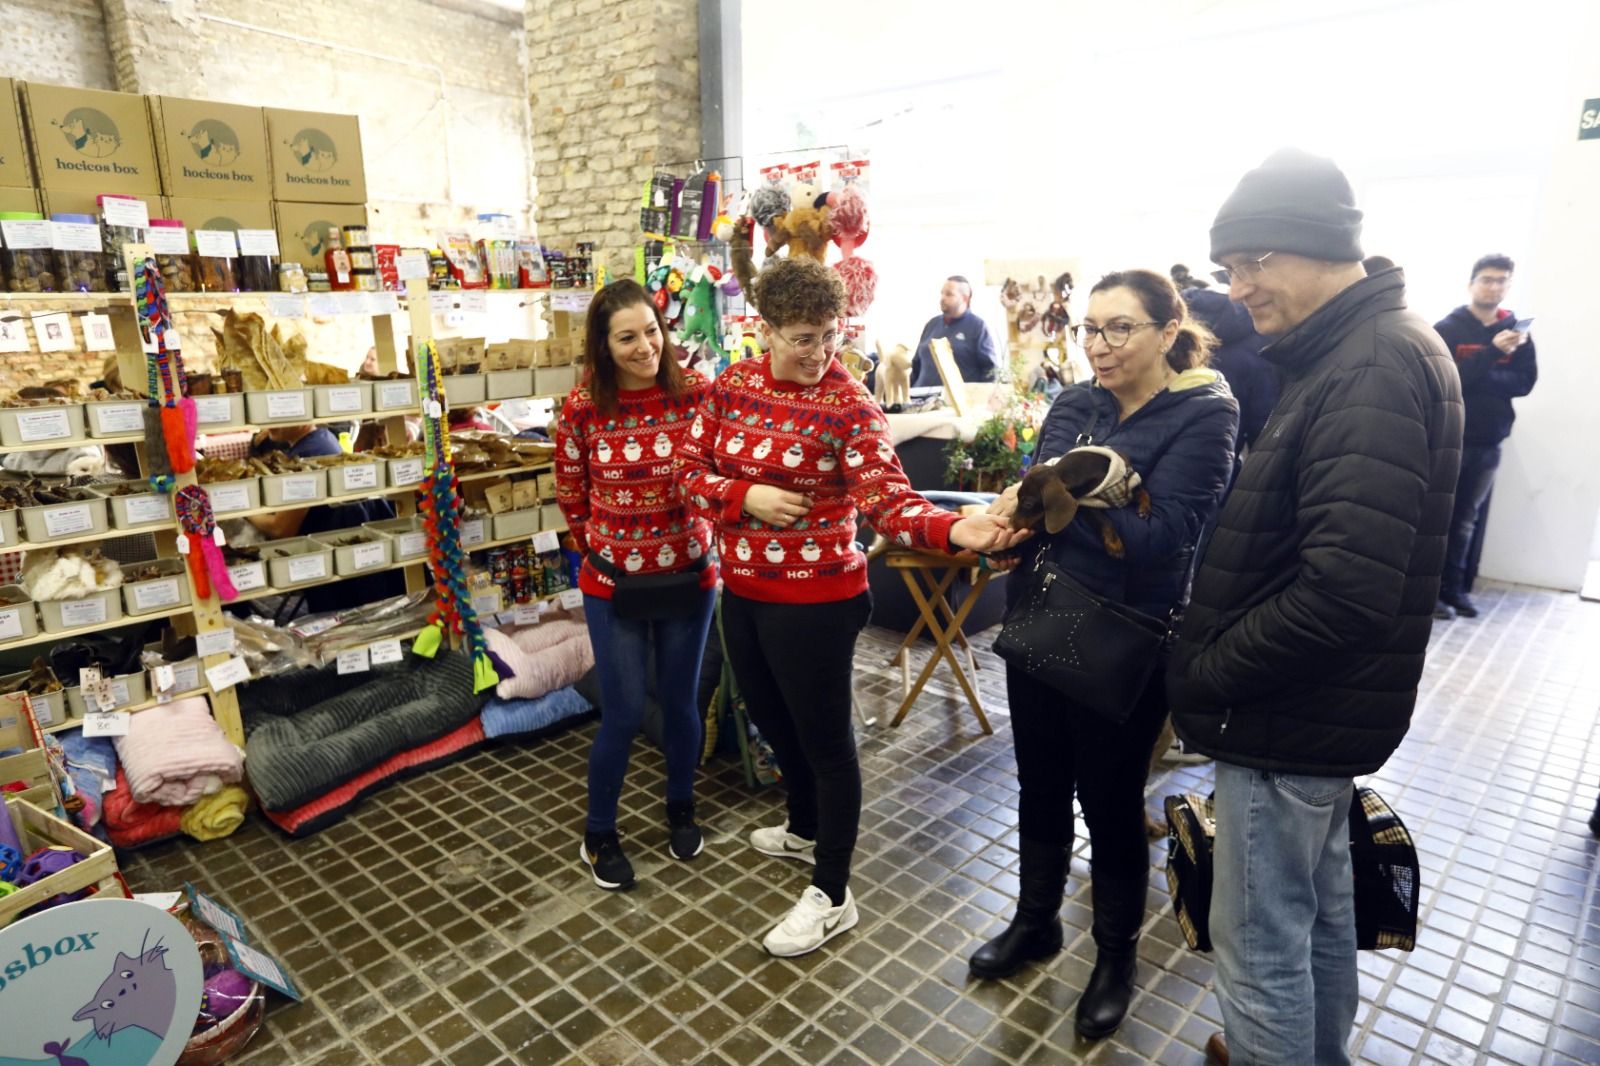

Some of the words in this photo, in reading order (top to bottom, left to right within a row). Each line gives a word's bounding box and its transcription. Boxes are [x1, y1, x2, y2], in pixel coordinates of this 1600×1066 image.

[55, 157, 111, 173] hocicos
[113, 162, 139, 175] box
[182, 166, 230, 180] hocicos
[232, 169, 254, 182] box
[286, 172, 328, 185] hocicos
[330, 175, 351, 187] box
[683, 443, 702, 456] HO!
[602, 469, 624, 480] HO!
[741, 464, 762, 477] HO!
[793, 477, 822, 486] HO!
[860, 467, 887, 481] HO!
[733, 567, 754, 577] HO!
[786, 569, 814, 579] HO!
